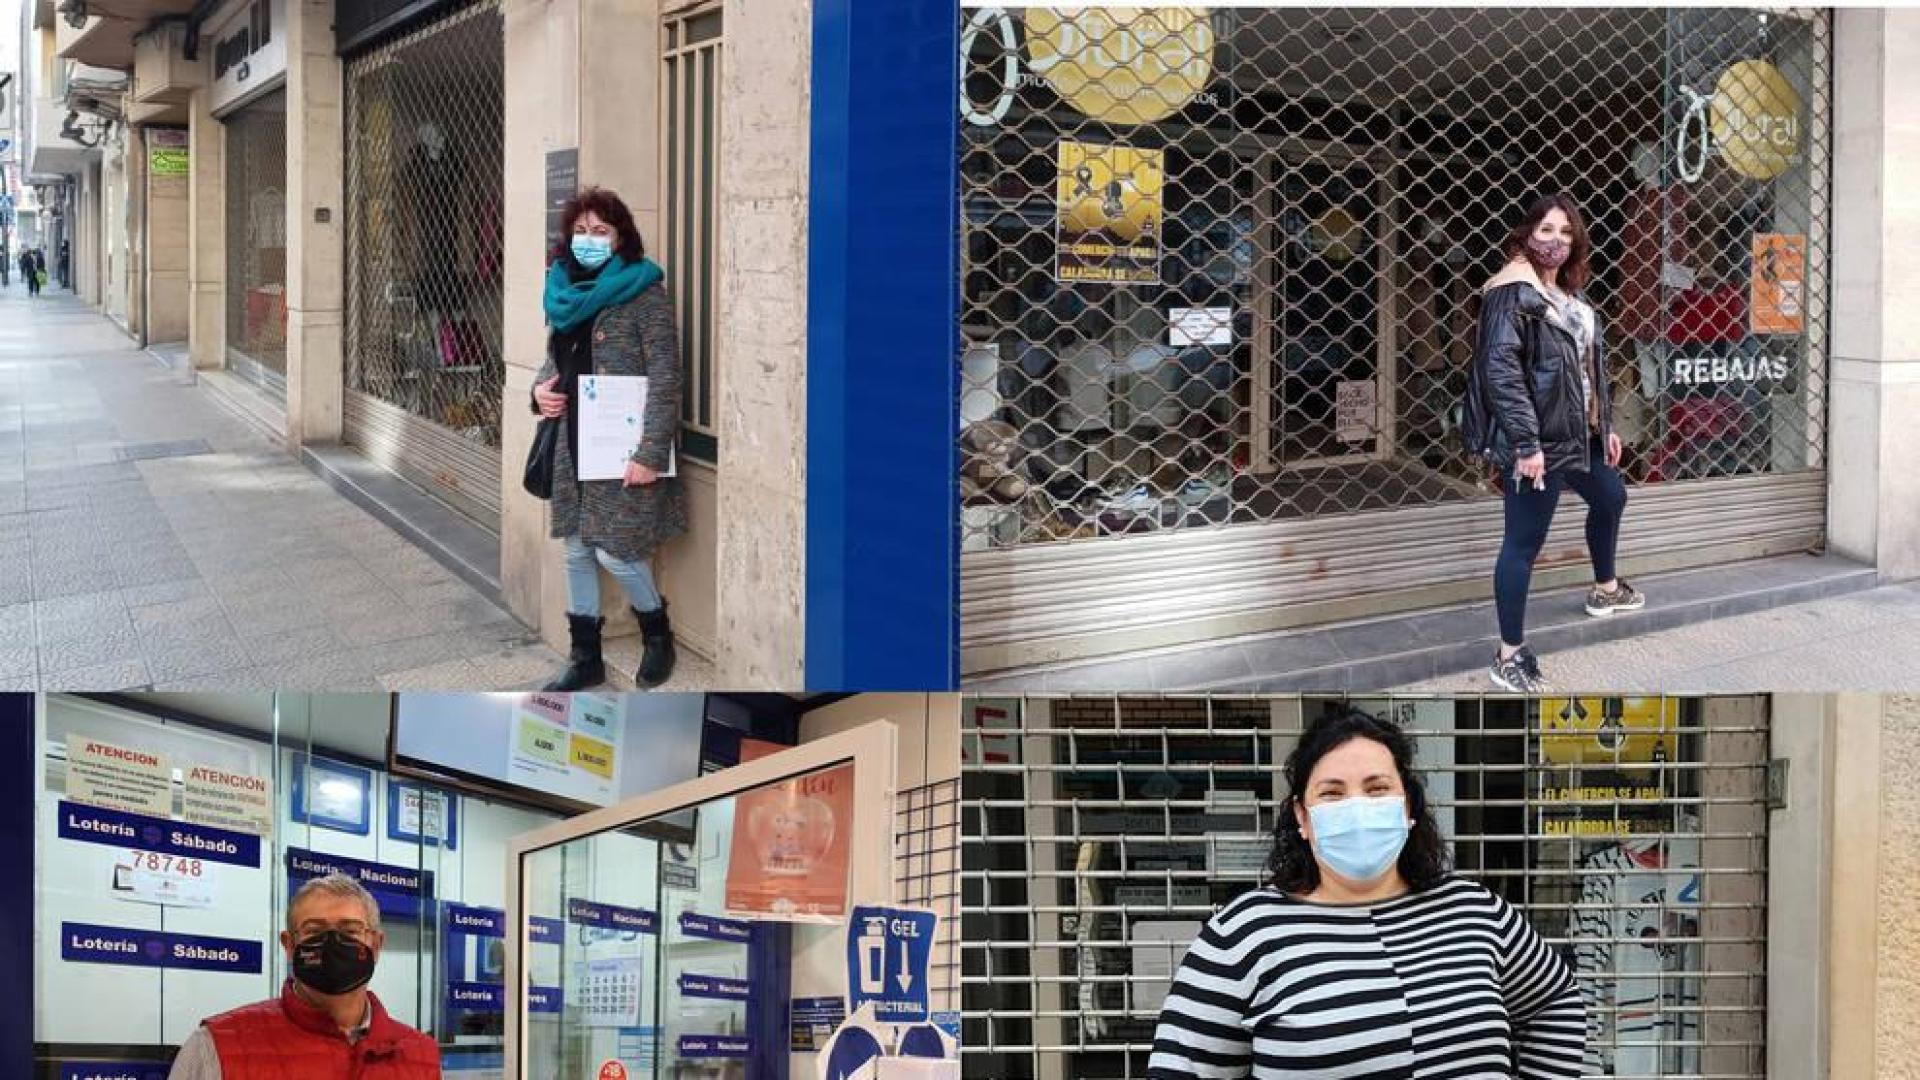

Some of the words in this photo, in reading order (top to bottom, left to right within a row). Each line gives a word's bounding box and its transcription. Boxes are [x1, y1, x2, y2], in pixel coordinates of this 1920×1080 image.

[1674, 356, 1788, 384] REBAJAS
[171, 831, 238, 854] Sábado
[131, 851, 203, 877] 78748
[360, 868, 419, 888] Nacional
[891, 917, 920, 938] GEL
[173, 943, 240, 963] Sábado
